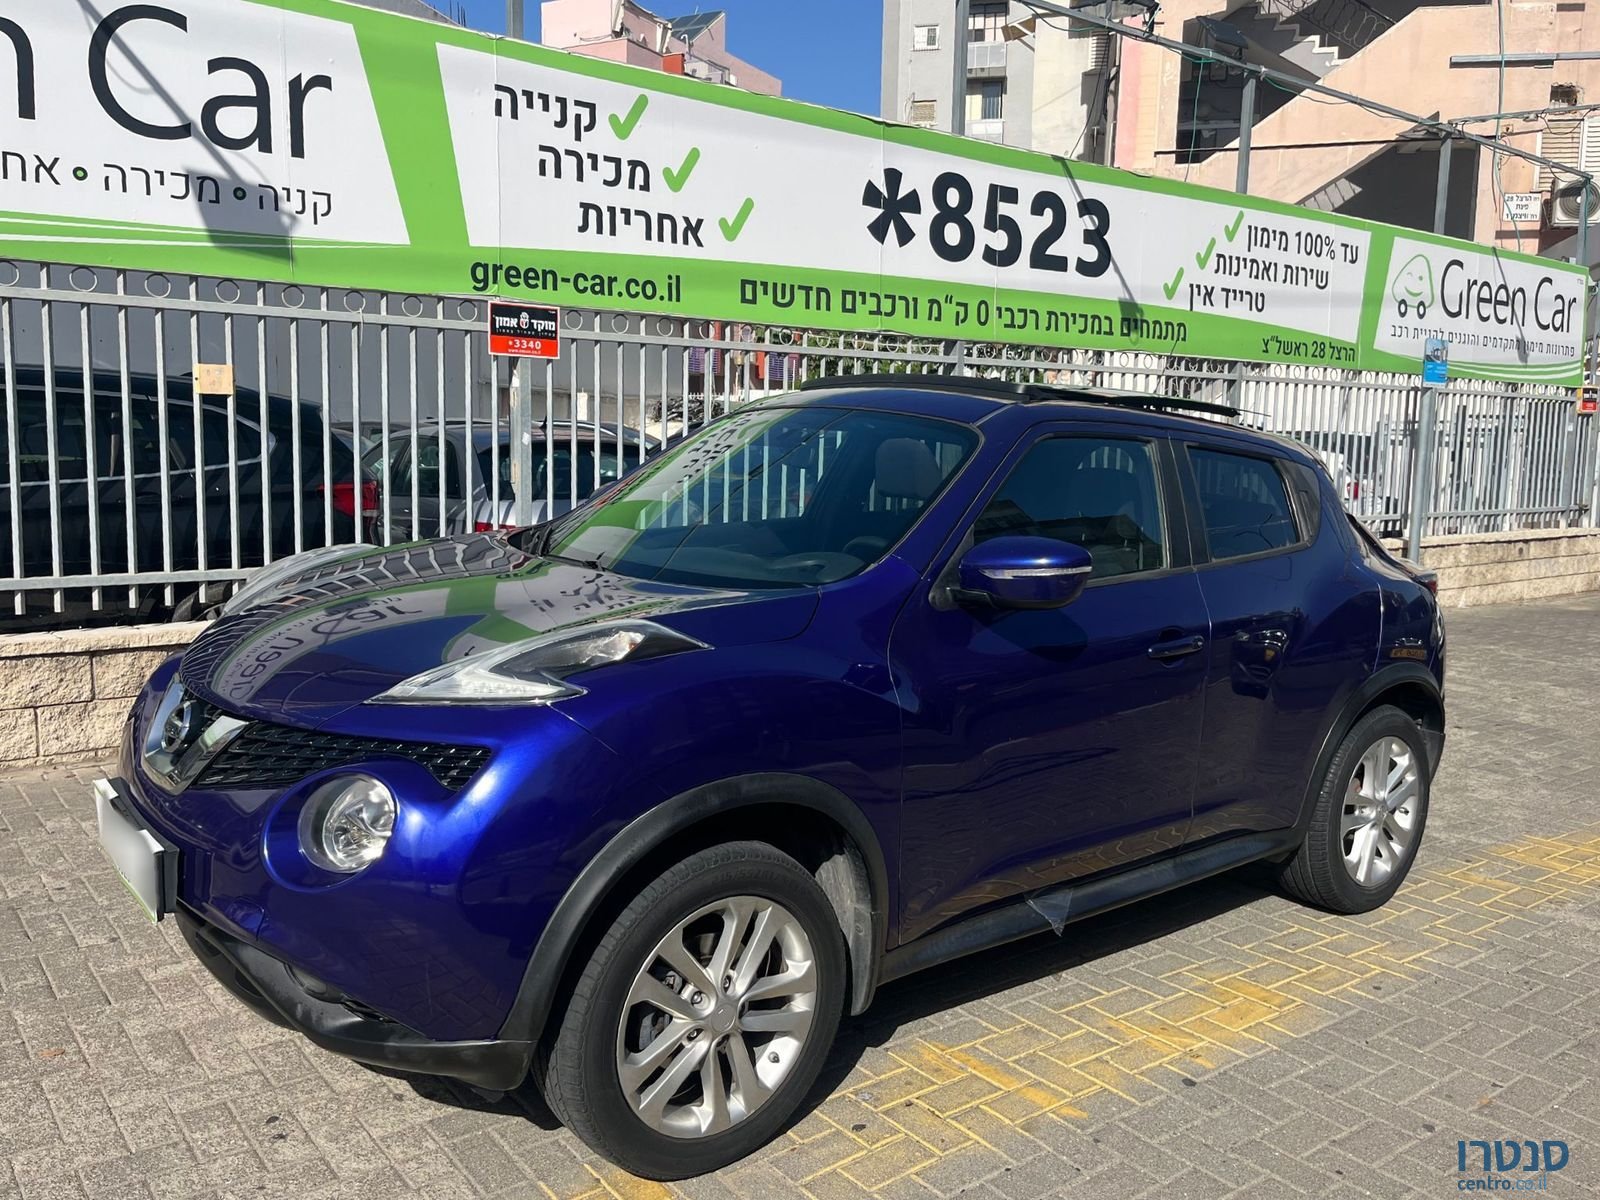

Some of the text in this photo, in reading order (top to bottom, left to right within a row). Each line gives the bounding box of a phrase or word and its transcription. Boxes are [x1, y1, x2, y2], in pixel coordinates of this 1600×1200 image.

[88, 4, 333, 160] Car
[494, 84, 597, 142] קנייה
[104, 163, 221, 205] מכירה
[538, 144, 650, 193] מכירה
[258, 183, 332, 225] קניה
[577, 202, 704, 248] אחריות
[1247, 224, 1359, 265] עד 100% מימון
[470, 259, 681, 302] green-car.co.il
[1214, 253, 1330, 290] שירות ואמינות
[740, 278, 831, 312] חדשים
[841, 289, 919, 319] ורכבים
[1189, 283, 1266, 313] טרייד אין
[1440, 258, 1577, 333] Green Car
[495, 316, 556, 331] מוקד אמון
[976, 299, 990, 327] 0
[996, 306, 1040, 330] רכבי
[1045, 310, 1115, 337] במכירת
[1120, 316, 1187, 342] מתמחים
[1390, 324, 1409, 338] רכב
[1311, 340, 1326, 359] 28
[1328, 341, 1356, 362] הרצל
[1545, 343, 1575, 357] פתרונות
